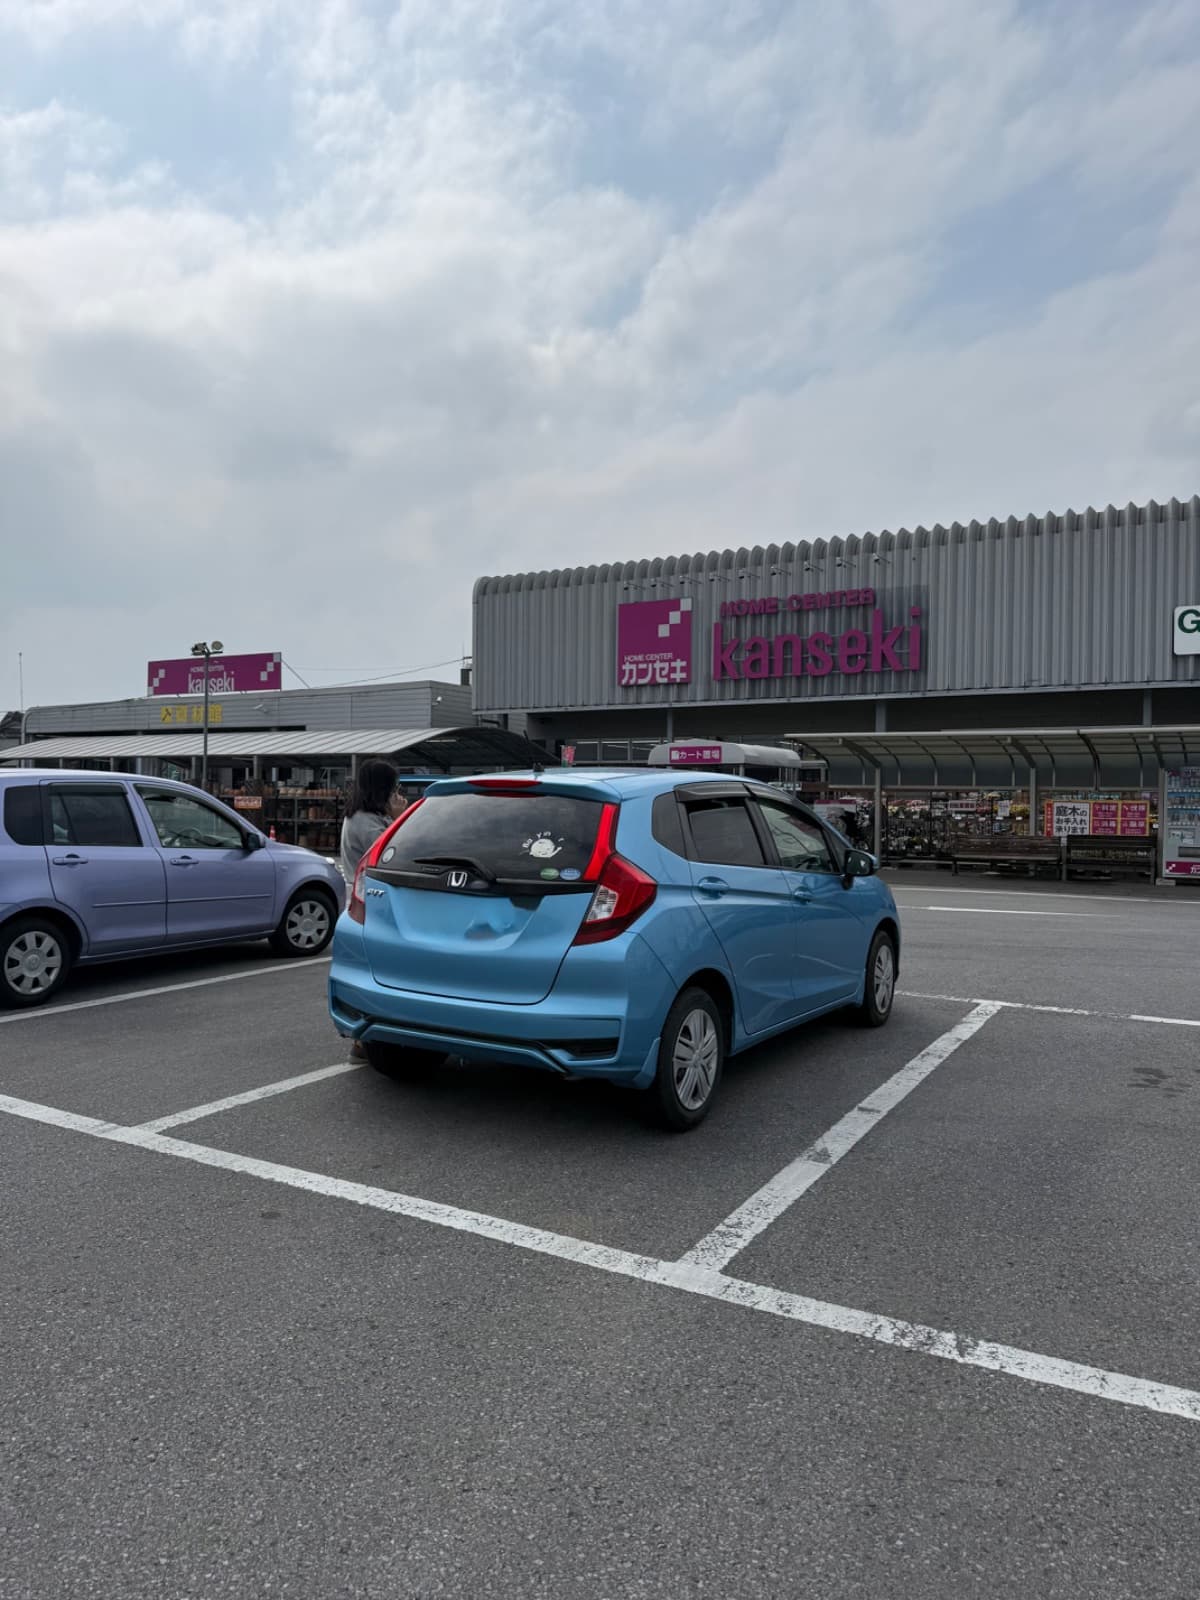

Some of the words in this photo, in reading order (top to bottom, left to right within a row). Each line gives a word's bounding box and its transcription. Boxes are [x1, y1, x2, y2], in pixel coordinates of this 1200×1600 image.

[720, 598, 777, 616] HOME
[787, 588, 874, 611] CENTER
[713, 606, 921, 681] kanseki
[624, 654, 644, 662] HOME
[645, 652, 673, 661] CENTER
[622, 659, 687, 685] カンセキ
[1056, 817, 1087, 826] お手入れ
